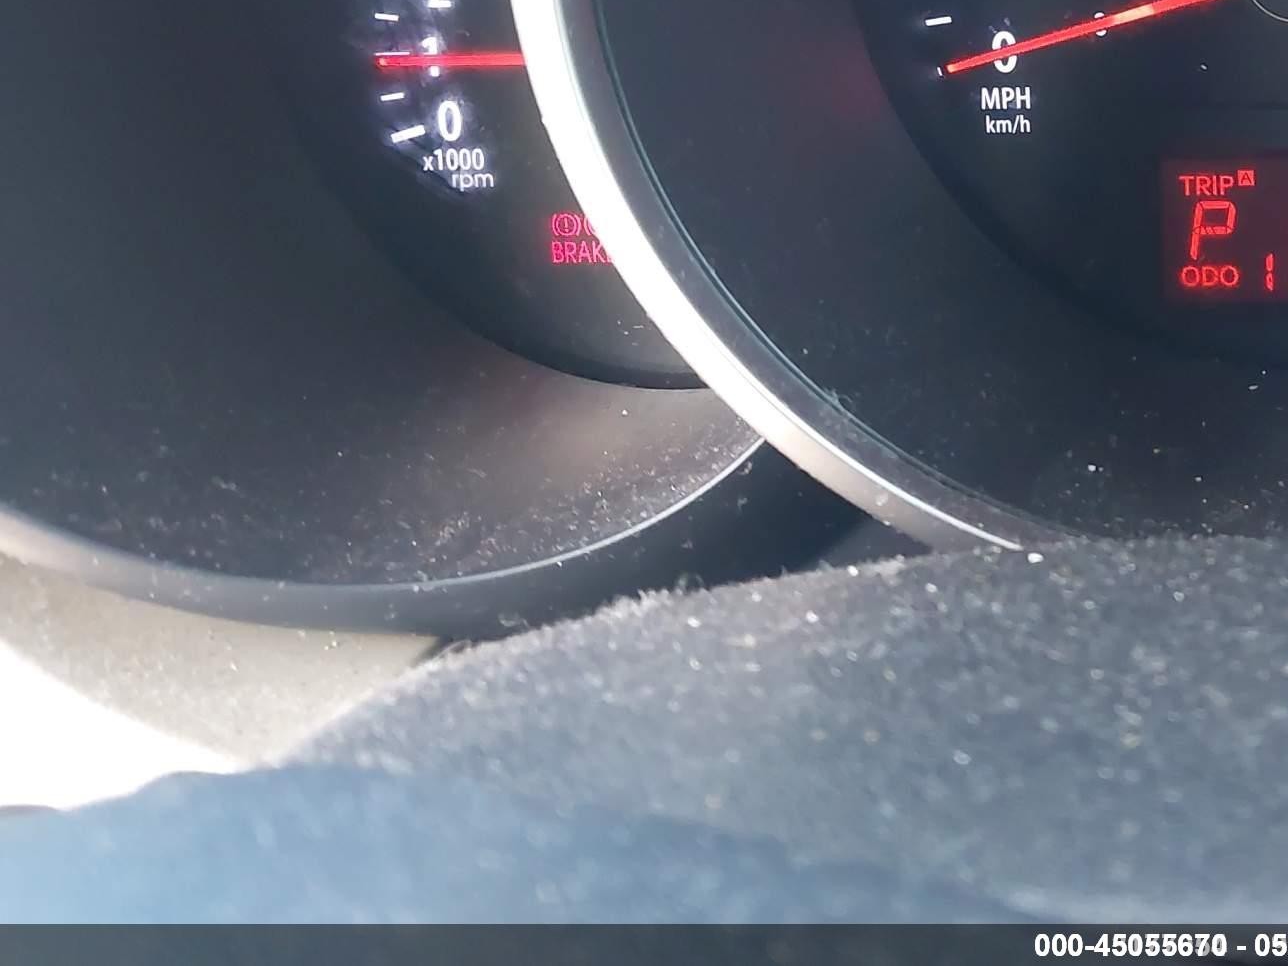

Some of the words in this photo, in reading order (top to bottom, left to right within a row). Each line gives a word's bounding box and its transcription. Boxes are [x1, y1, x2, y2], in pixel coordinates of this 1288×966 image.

[421, 37, 440, 76] 1
[991, 30, 1018, 73] 0
[981, 86, 1031, 110] MPH
[436, 99, 464, 142] 0
[985, 114, 1031, 134] km/h
[422, 147, 486, 172] x1000
[451, 172, 496, 192] rpm
[1179, 175, 1234, 196] TRIP
[1240, 172, 1253, 185] A
[1190, 200, 1236, 260] P
[551, 240, 613, 264] BRAK
[1181, 265, 1239, 287] ODO
